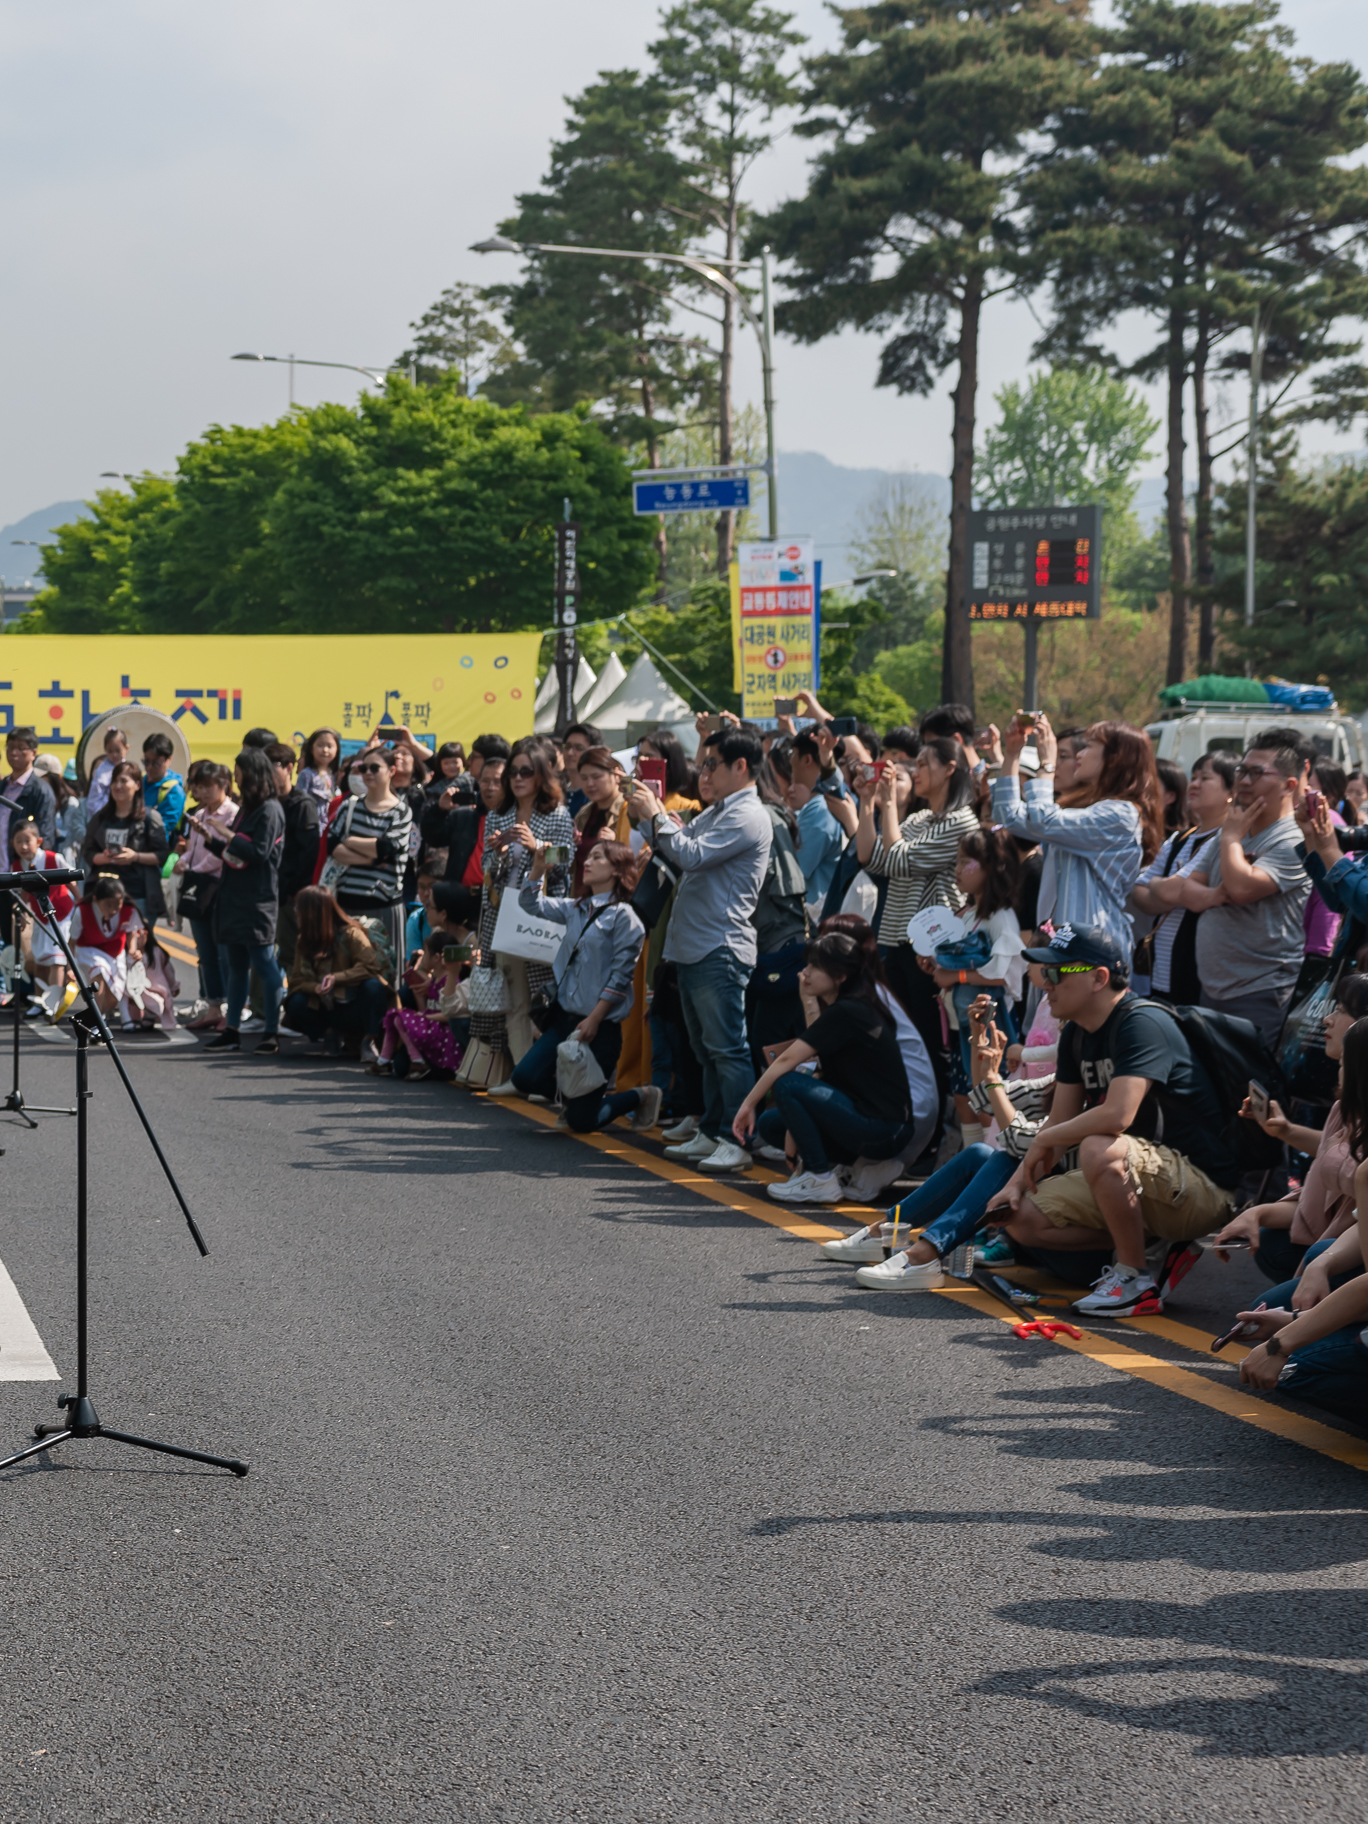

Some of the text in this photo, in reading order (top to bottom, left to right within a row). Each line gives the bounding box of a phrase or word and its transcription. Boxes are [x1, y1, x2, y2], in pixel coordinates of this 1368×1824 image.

[663, 483, 711, 501] 능동로
[745, 623, 811, 646] 대공원 사거리
[745, 671, 812, 694] 군자역 사거리
[516, 924, 562, 942] BAOBA
